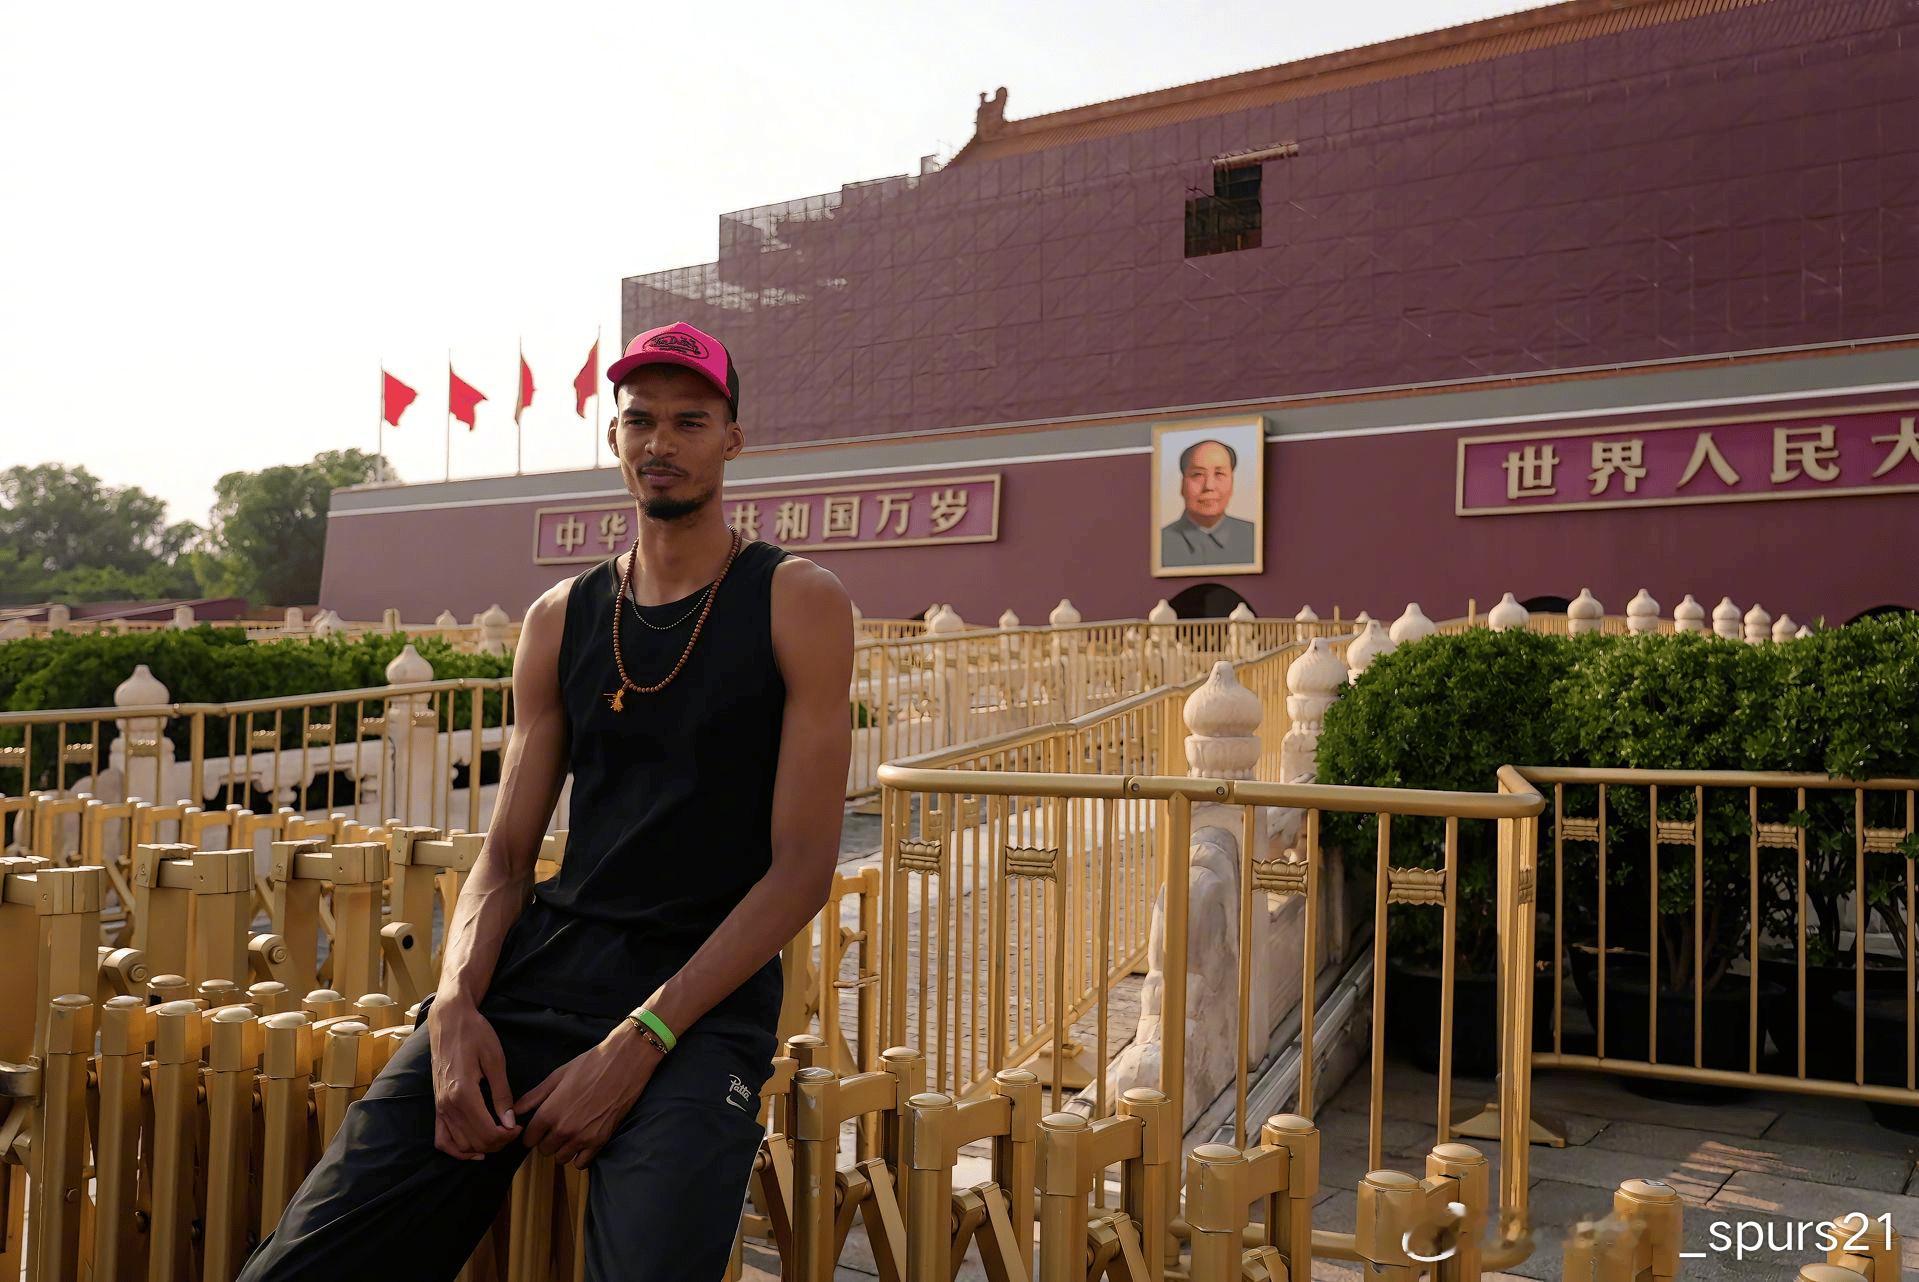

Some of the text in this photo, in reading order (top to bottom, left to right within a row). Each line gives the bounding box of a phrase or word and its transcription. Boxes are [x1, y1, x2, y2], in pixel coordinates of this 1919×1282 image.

[556, 488, 969, 555] 中华共和国万岁
[729, 1074, 752, 1102] Patta
